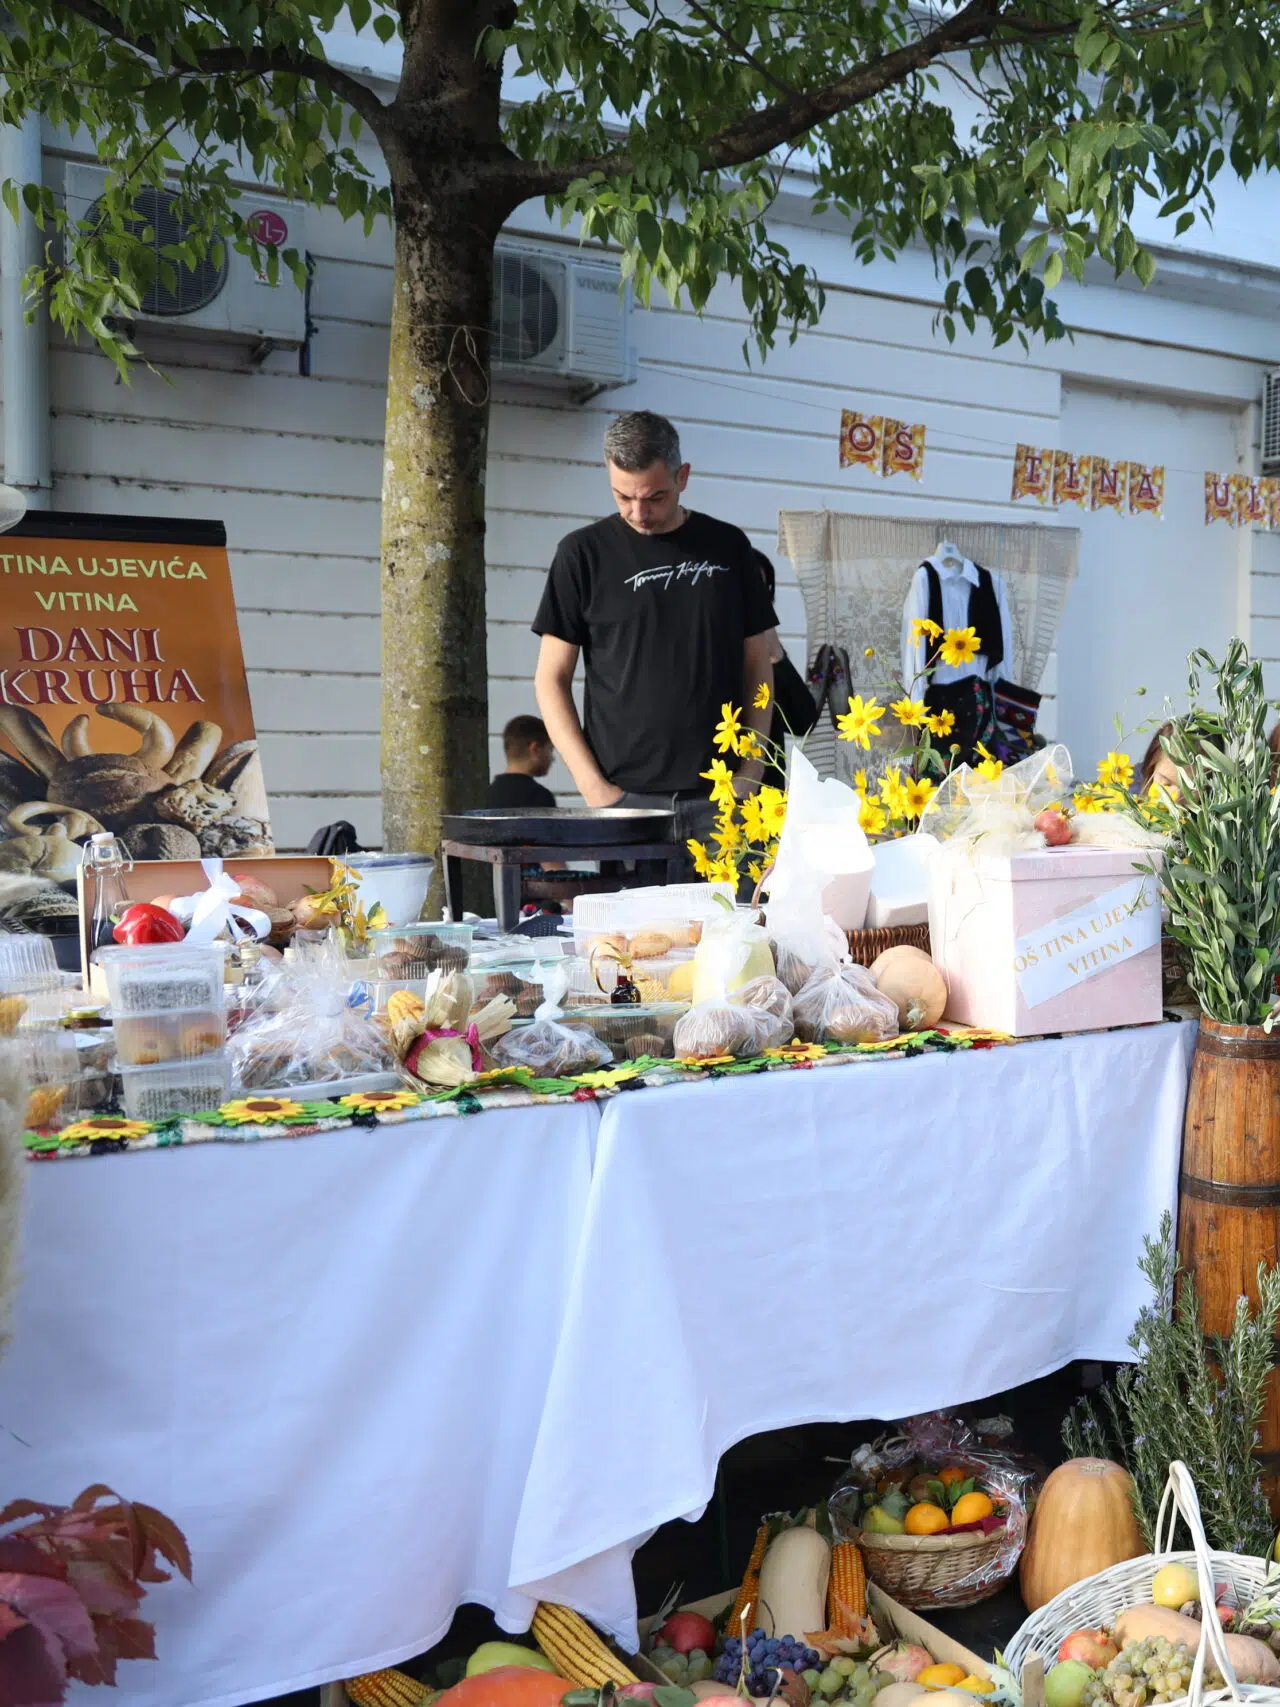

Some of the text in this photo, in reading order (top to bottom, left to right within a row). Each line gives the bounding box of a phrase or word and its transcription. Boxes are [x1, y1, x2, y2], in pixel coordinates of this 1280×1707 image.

[848, 422, 914, 462] OŠ
[1024, 456, 1157, 501] TINA
[0, 553, 208, 580] TINA UJEVIĆA
[624, 565, 674, 592] Tommy
[33, 590, 139, 613] VITINA
[14, 625, 165, 663] DANI
[0, 668, 205, 705] KRUHA
[1012, 947, 1040, 974] OŠ
[1040, 927, 1088, 958] TINA
[1067, 935, 1133, 975] VITINA
